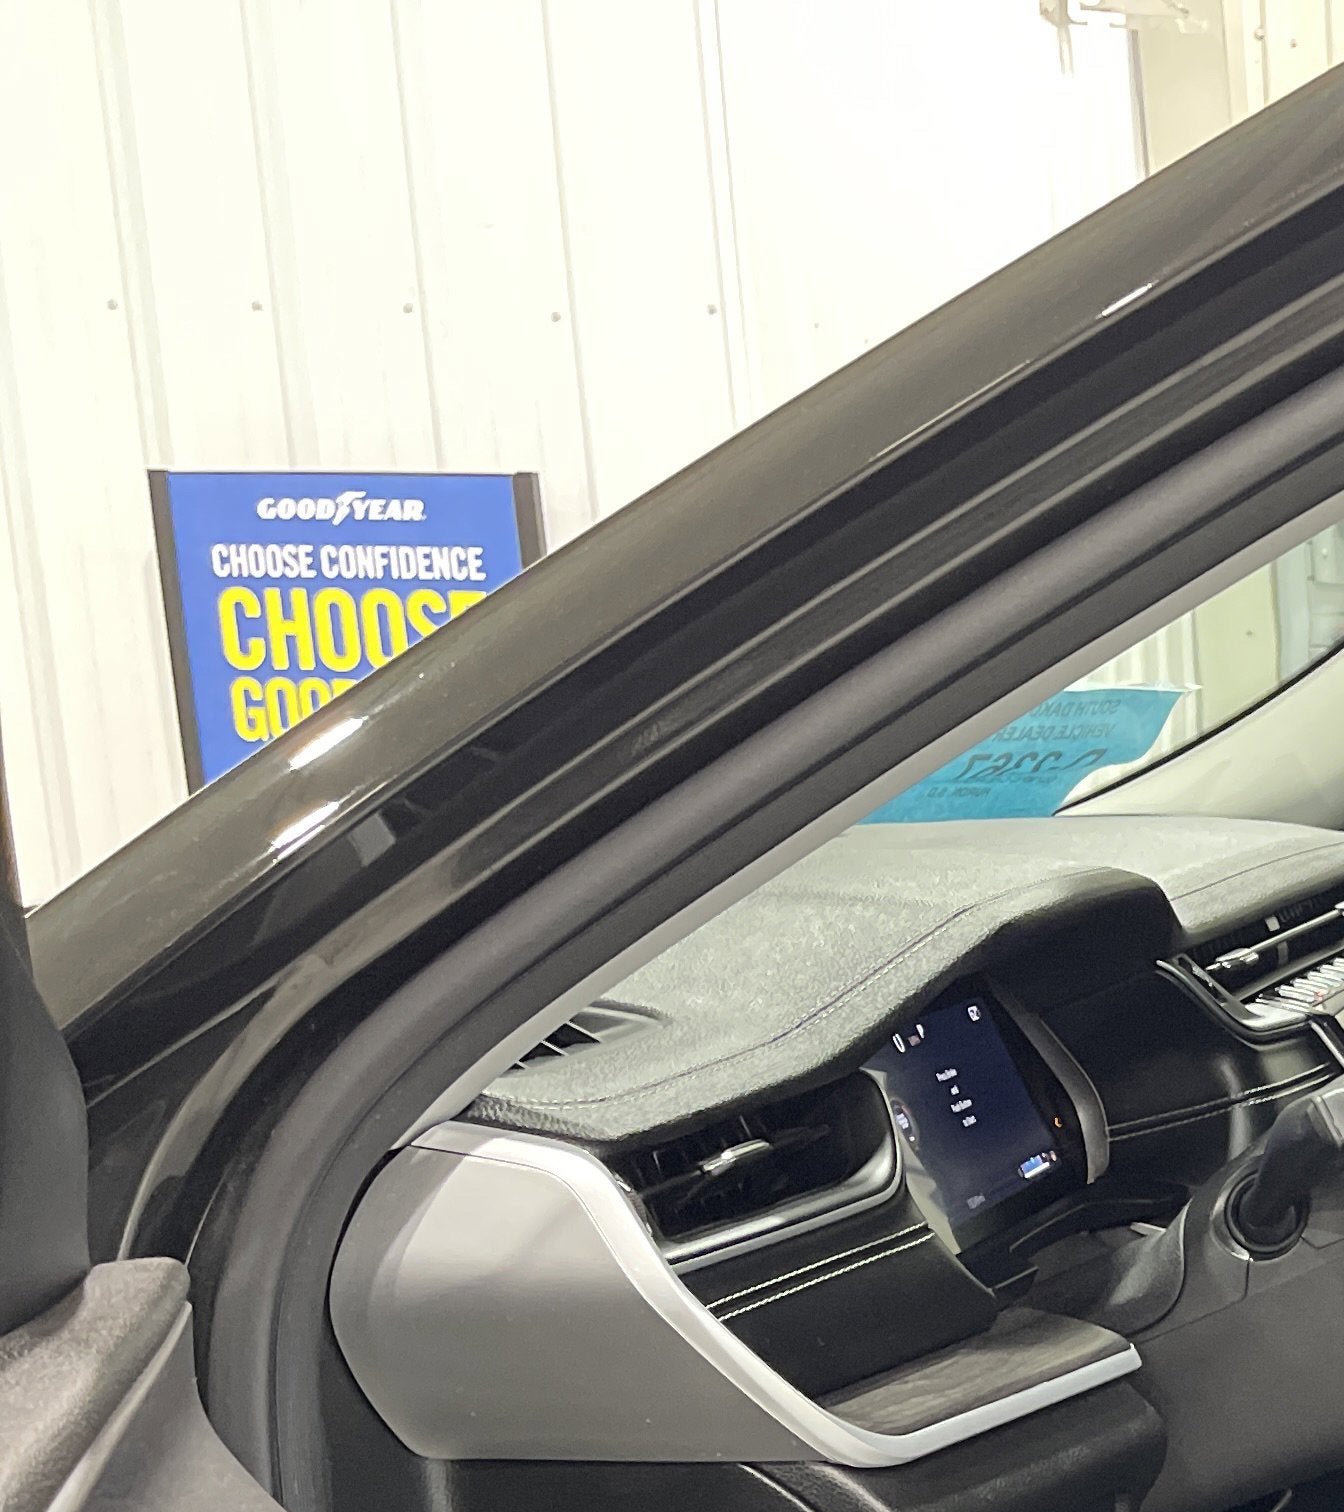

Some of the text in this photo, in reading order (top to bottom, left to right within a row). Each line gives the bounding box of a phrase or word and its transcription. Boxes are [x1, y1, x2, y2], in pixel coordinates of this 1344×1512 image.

[256, 490, 426, 526] GOODYEAR
[212, 544, 487, 581] CHOOSE CONFIDENCE
[217, 587, 488, 672] CHOOS
[231, 677, 358, 742] GOO
